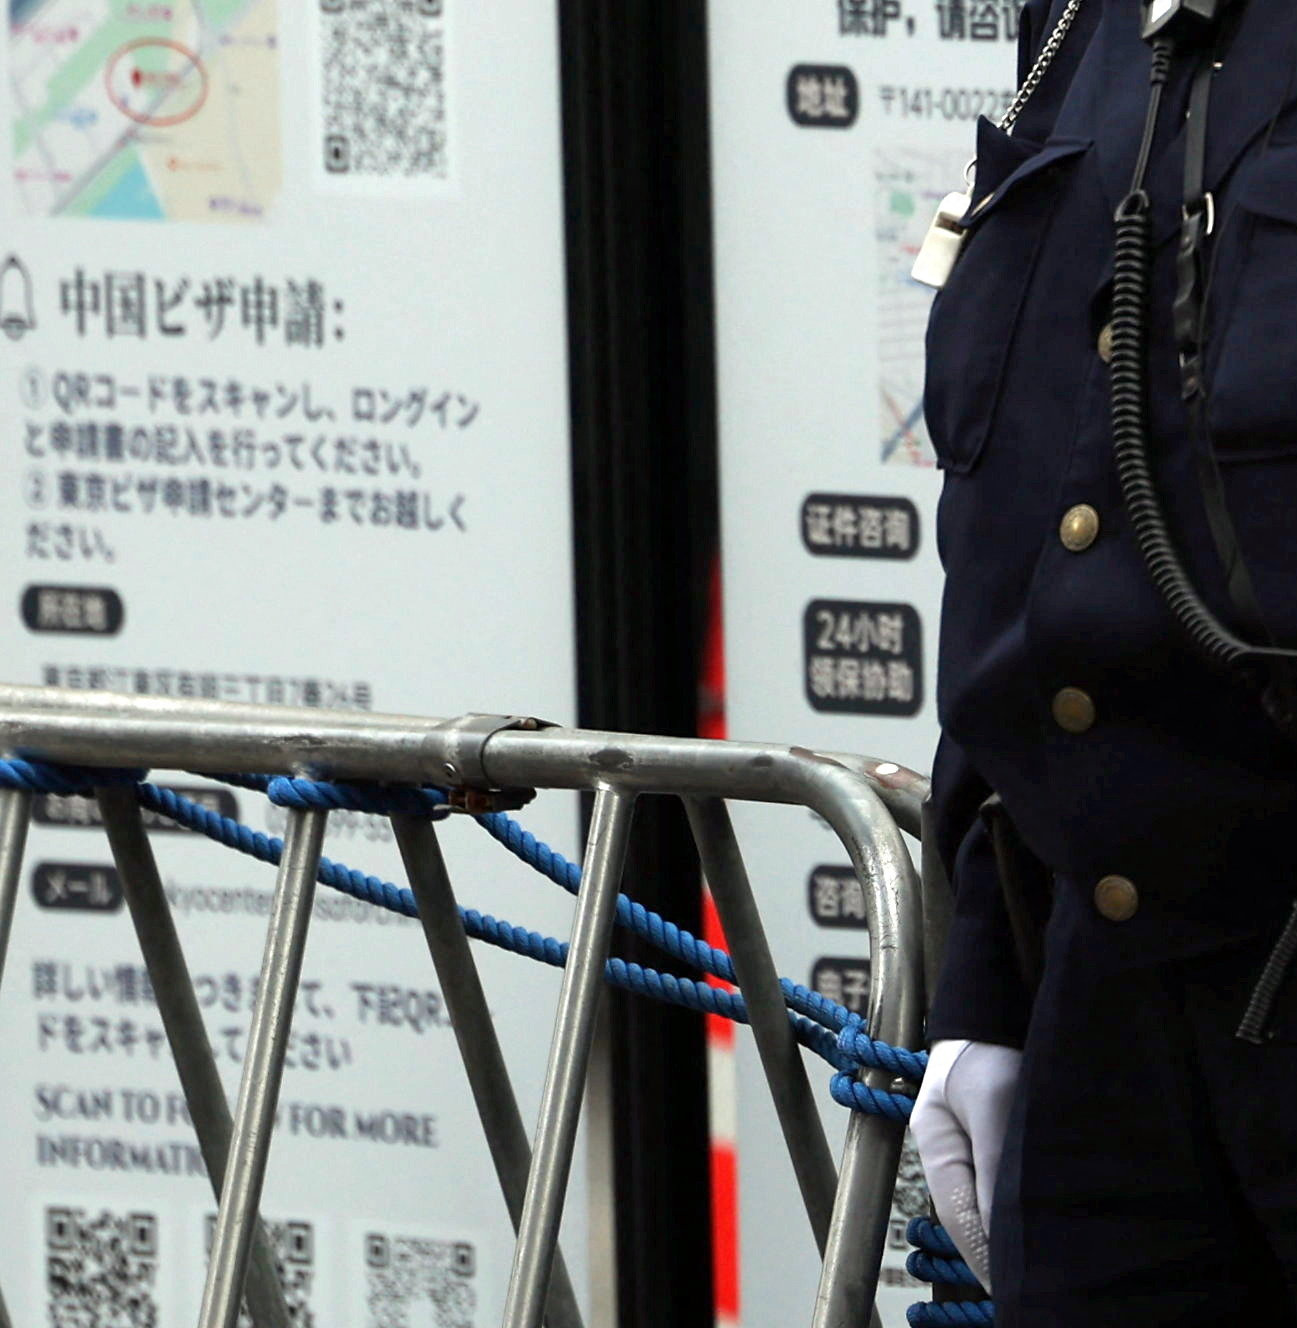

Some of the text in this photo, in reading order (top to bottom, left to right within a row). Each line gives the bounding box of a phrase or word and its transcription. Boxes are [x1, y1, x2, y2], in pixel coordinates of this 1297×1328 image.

[34, 1085, 113, 1121] SCAN
[119, 1088, 162, 1125] TO
[288, 1102, 349, 1140] FOR
[353, 1111, 438, 1149] MORE
